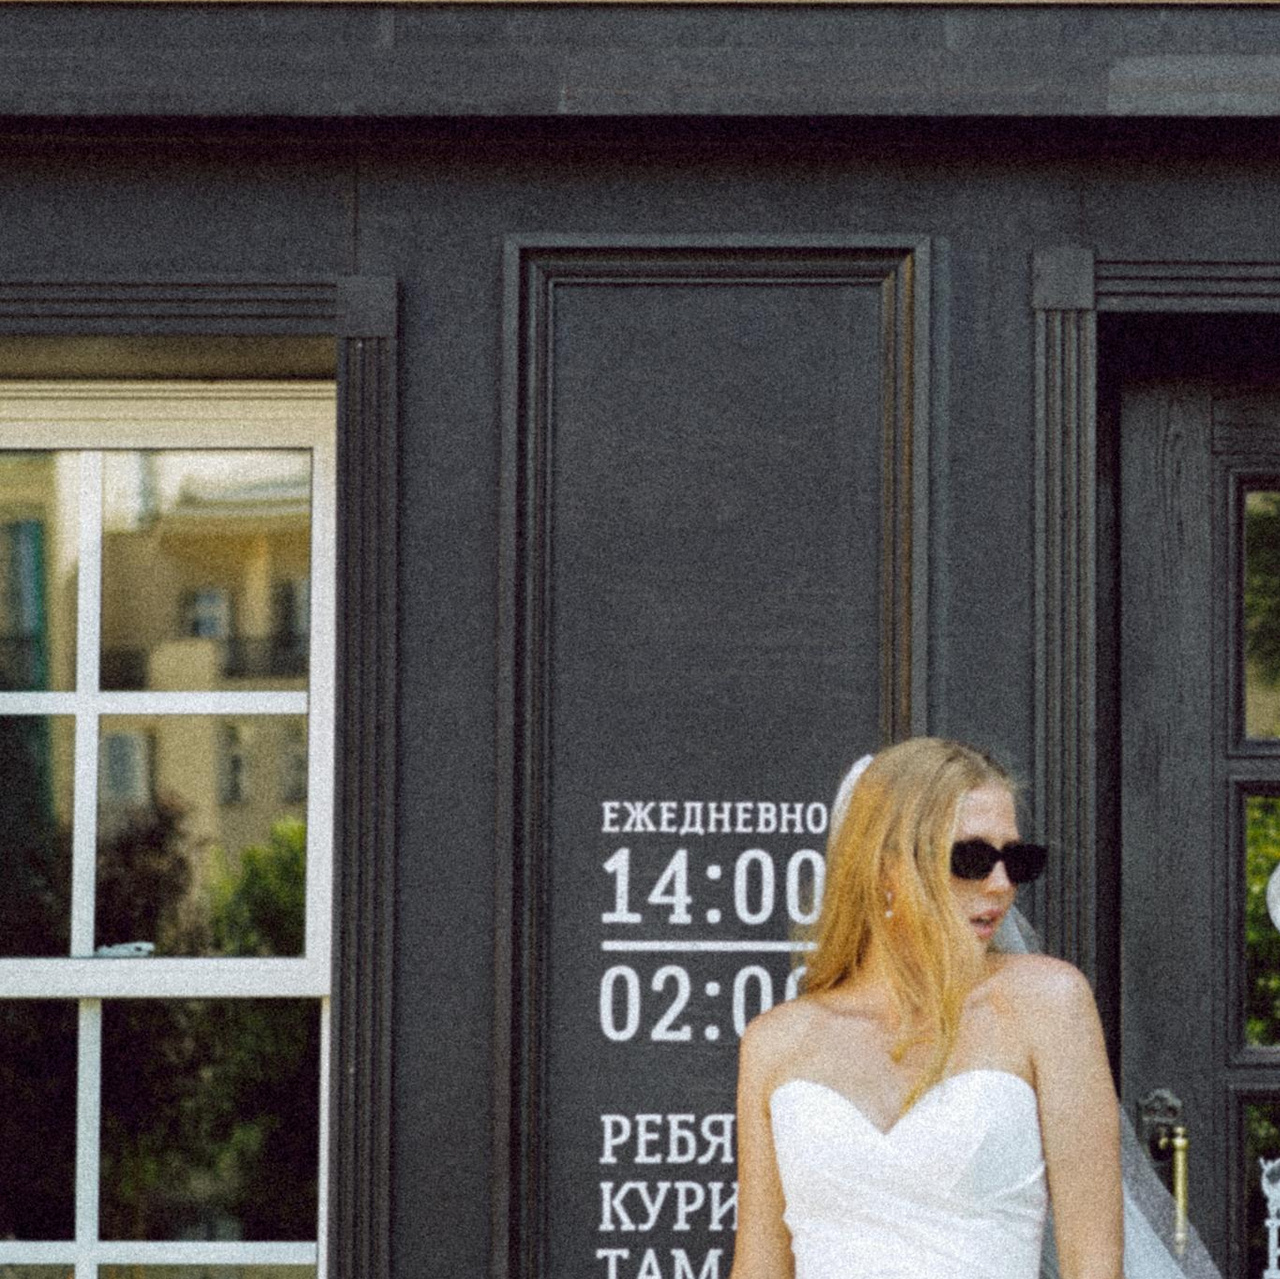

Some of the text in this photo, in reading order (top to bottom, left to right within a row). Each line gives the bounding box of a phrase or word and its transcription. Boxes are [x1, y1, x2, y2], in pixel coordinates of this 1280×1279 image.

[602, 801, 828, 835] ЕЖЕДНЕВНО
[602, 847, 827, 925] 14:00
[599, 1113, 736, 1164] РЕБЯ
[599, 1180, 739, 1232] КУРИ
